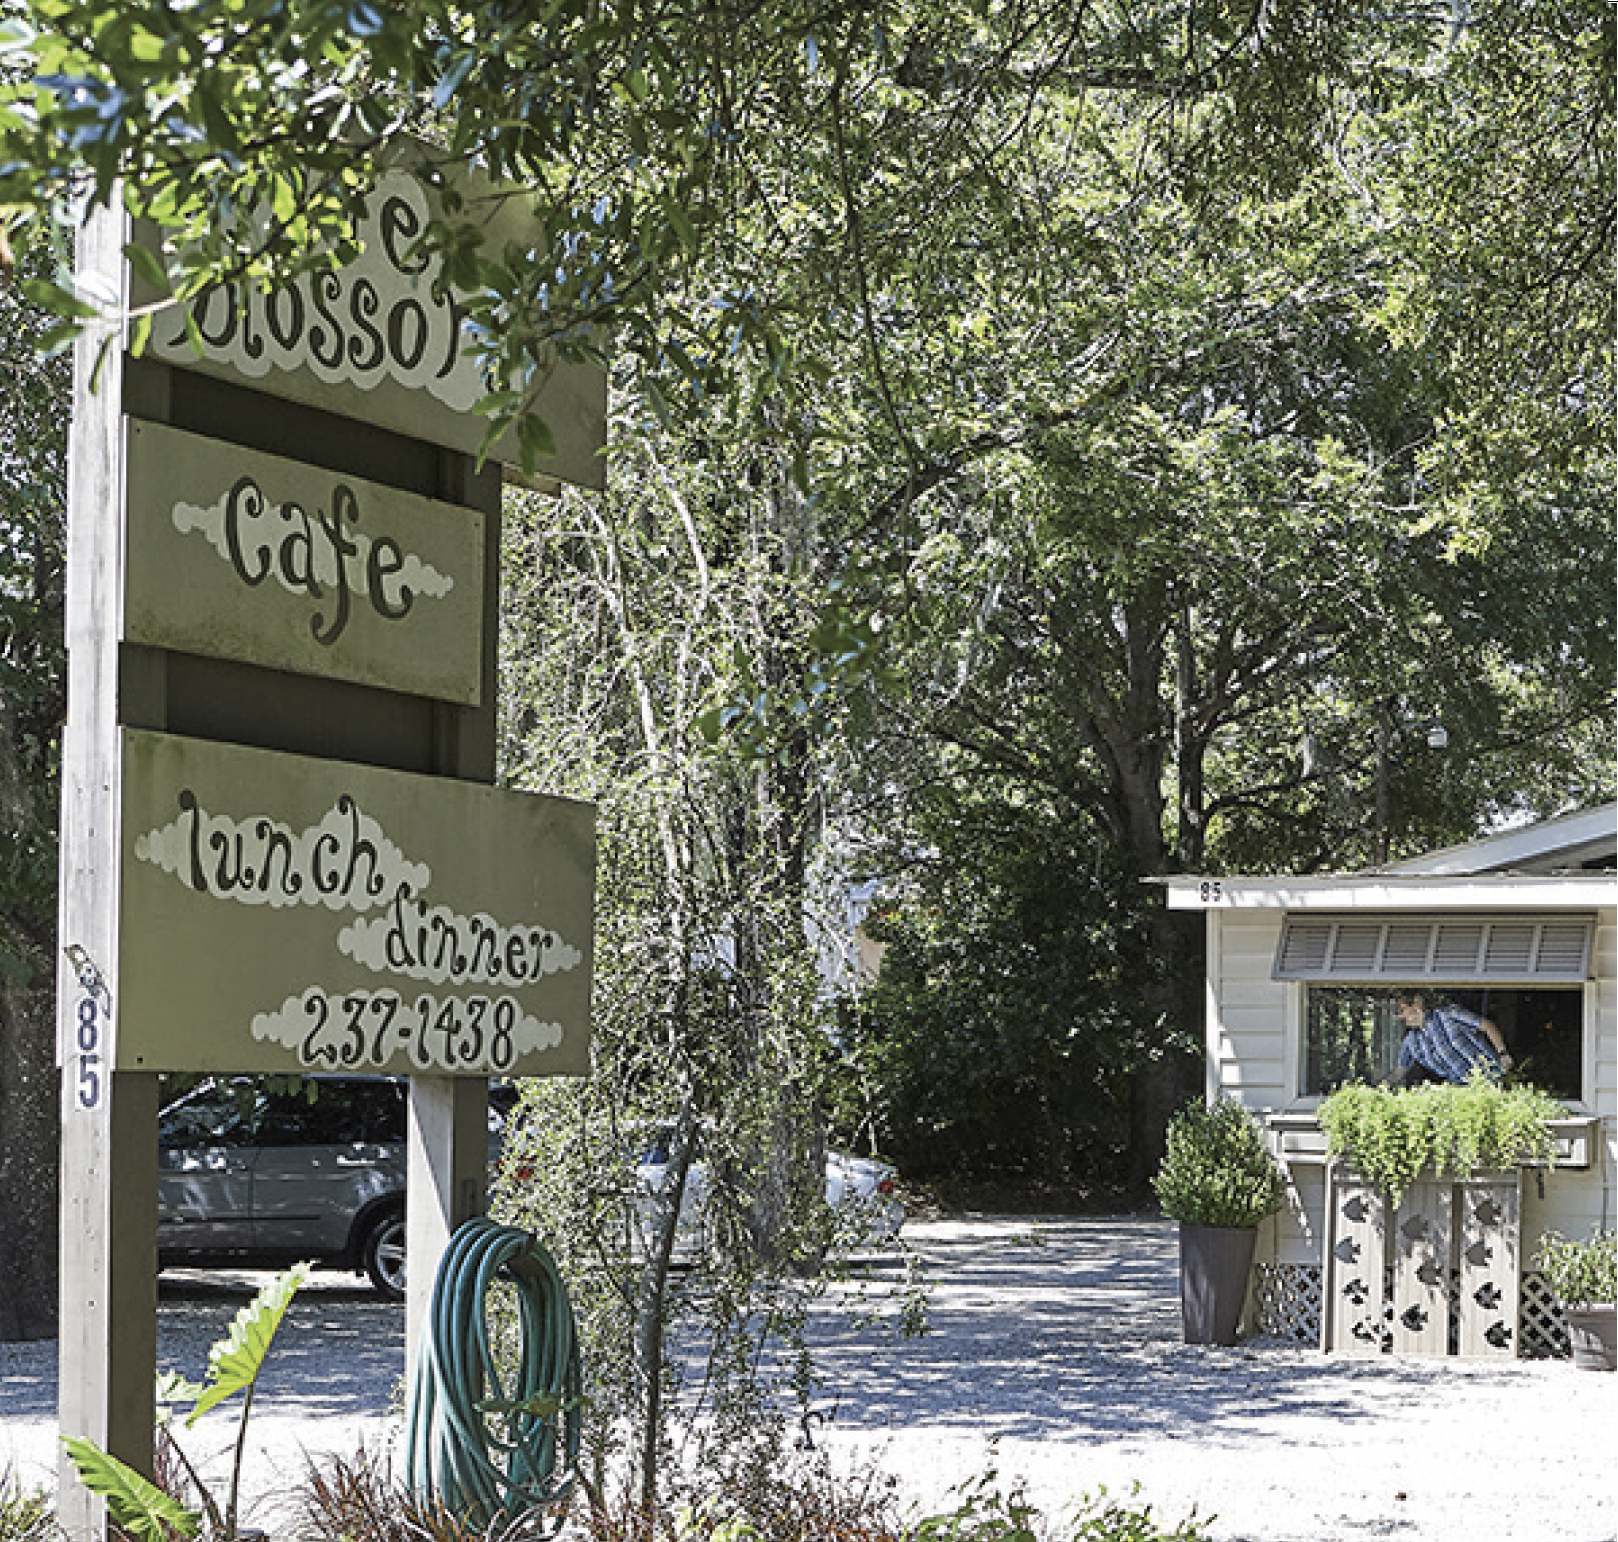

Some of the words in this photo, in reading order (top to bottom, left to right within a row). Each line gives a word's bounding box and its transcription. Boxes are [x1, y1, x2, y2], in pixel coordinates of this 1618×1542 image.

[225, 475, 413, 646] Cafe
[178, 788, 384, 896] lunch
[1200, 881, 1221, 902] 85
[386, 881, 553, 980] dinner
[302, 994, 516, 1069] 237-1438
